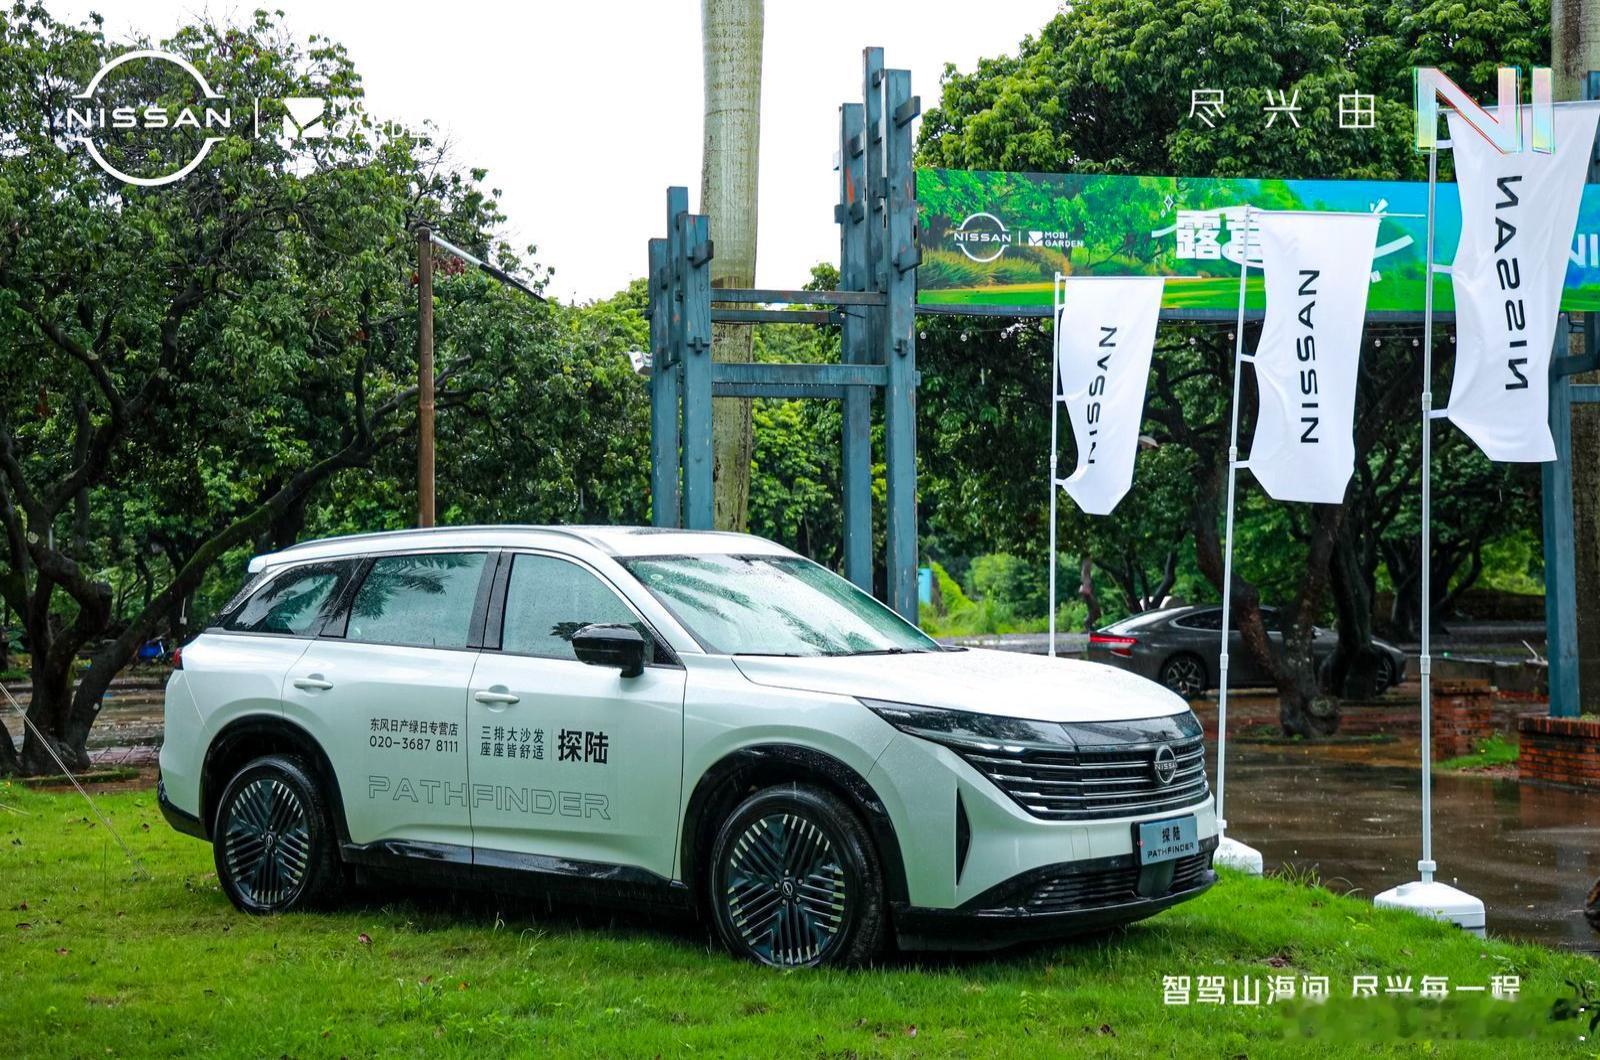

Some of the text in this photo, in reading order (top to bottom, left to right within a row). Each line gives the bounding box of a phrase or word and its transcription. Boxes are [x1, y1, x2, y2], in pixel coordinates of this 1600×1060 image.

[954, 232, 1012, 243] NISSAN
[1044, 231, 1069, 239] MOBI
[1044, 239, 1084, 248] GARDEN
[1296, 269, 1320, 443] NISSAN
[370, 718, 459, 736] 东风日产绿日专营店
[481, 725, 545, 744] 三排大沙发
[369, 735, 459, 753] 020-3687 8111
[480, 742, 545, 760] 座座皆舒适
[557, 728, 609, 764] 探陆
[368, 775, 612, 820] PATHFINDER
[1147, 842, 1194, 858] PATHFINDER
